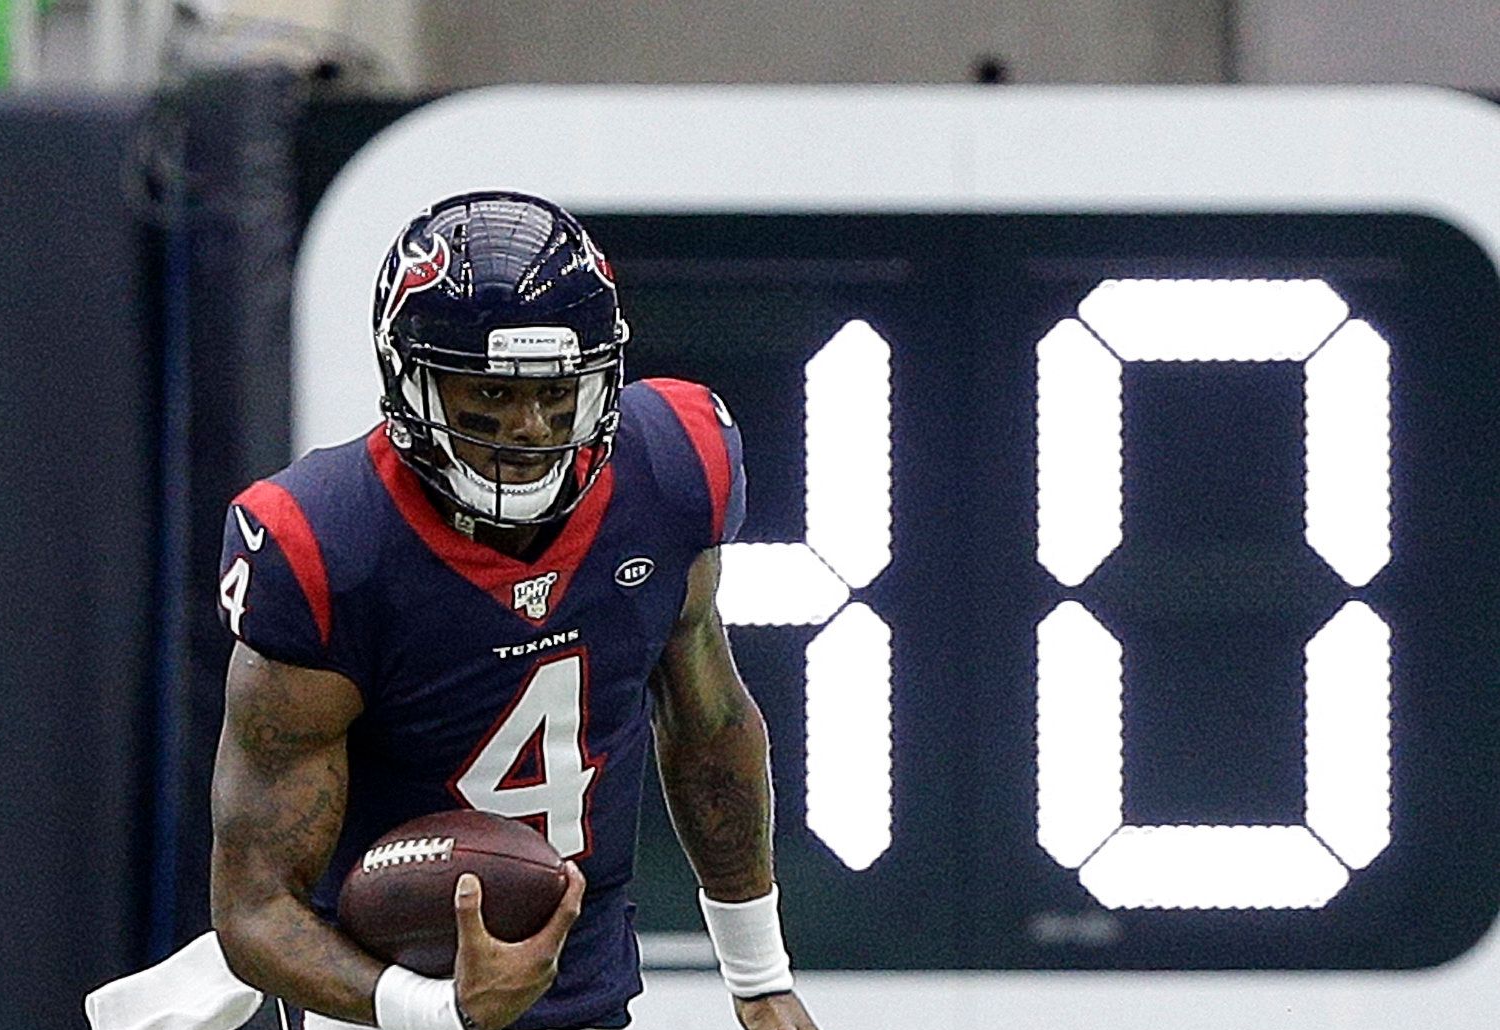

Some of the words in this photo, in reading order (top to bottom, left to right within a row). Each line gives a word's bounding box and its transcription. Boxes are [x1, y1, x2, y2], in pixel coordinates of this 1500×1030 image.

[220, 557, 247, 637] 4
[492, 628, 580, 659] TEXANS
[454, 654, 597, 859] 4
